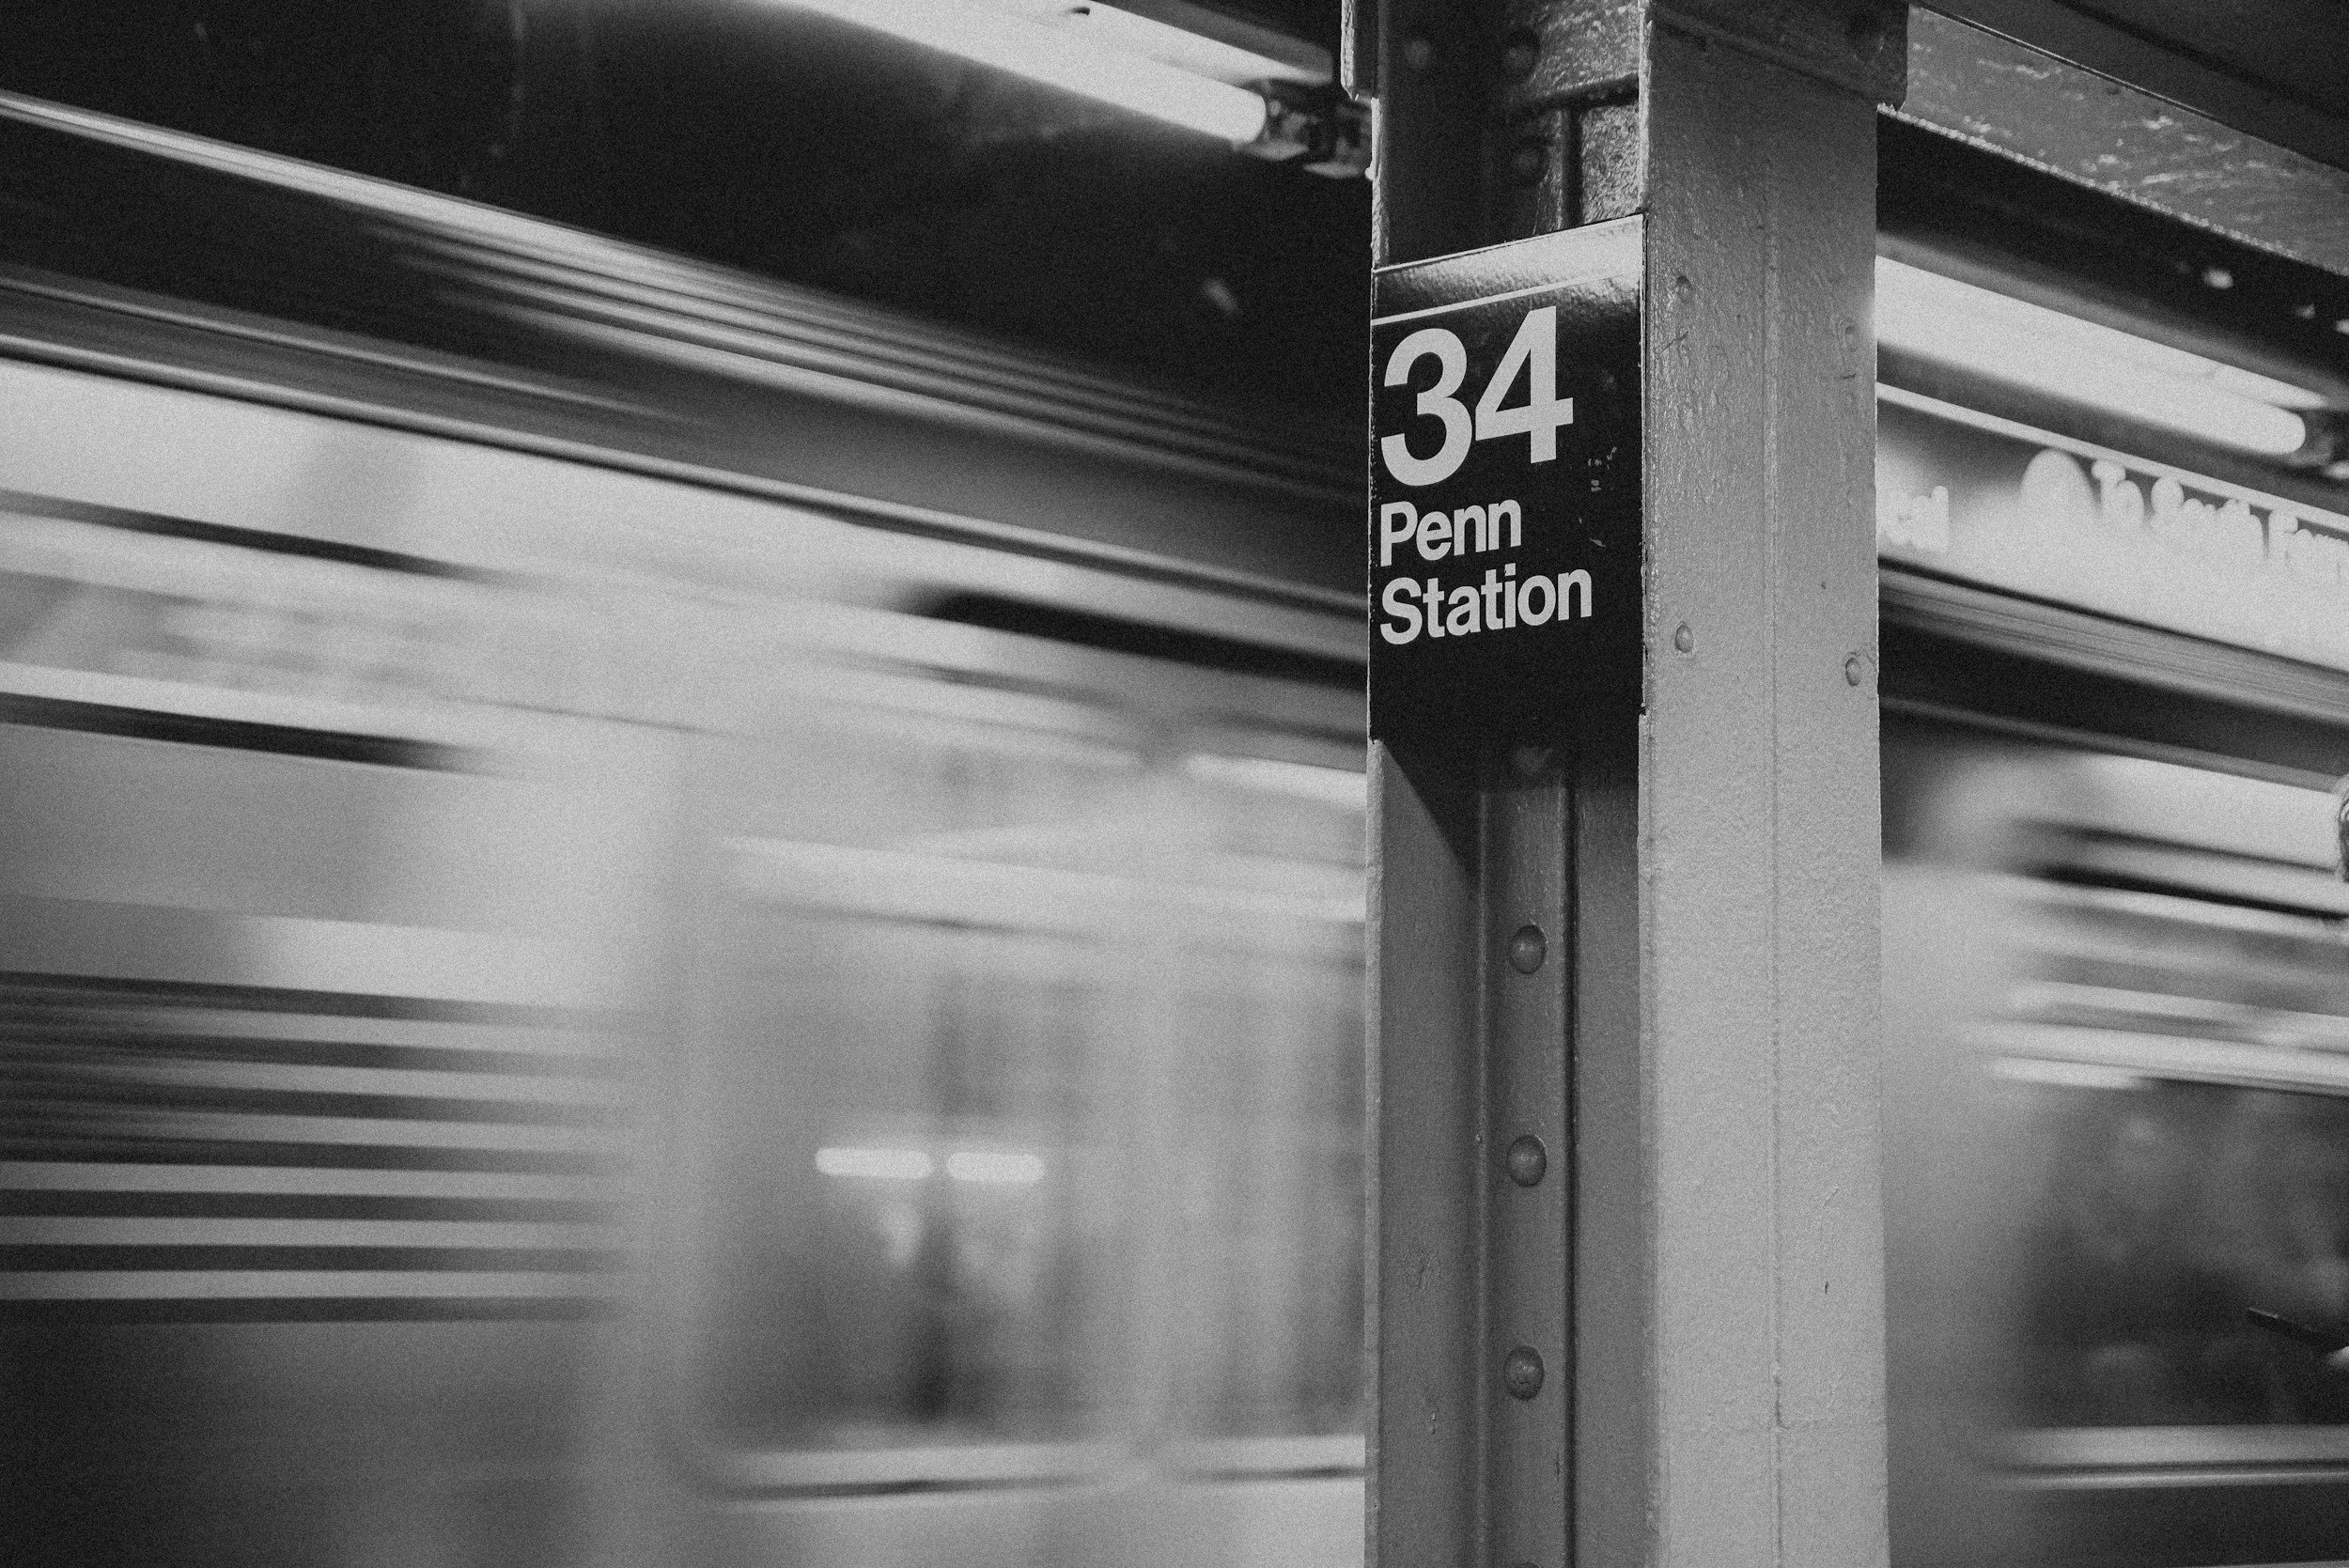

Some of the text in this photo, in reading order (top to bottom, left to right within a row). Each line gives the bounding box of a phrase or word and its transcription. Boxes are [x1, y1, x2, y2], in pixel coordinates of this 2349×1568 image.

[1380, 305, 1573, 487] 34
[1381, 500, 1521, 566] Penn
[1381, 564, 1592, 644] Station
